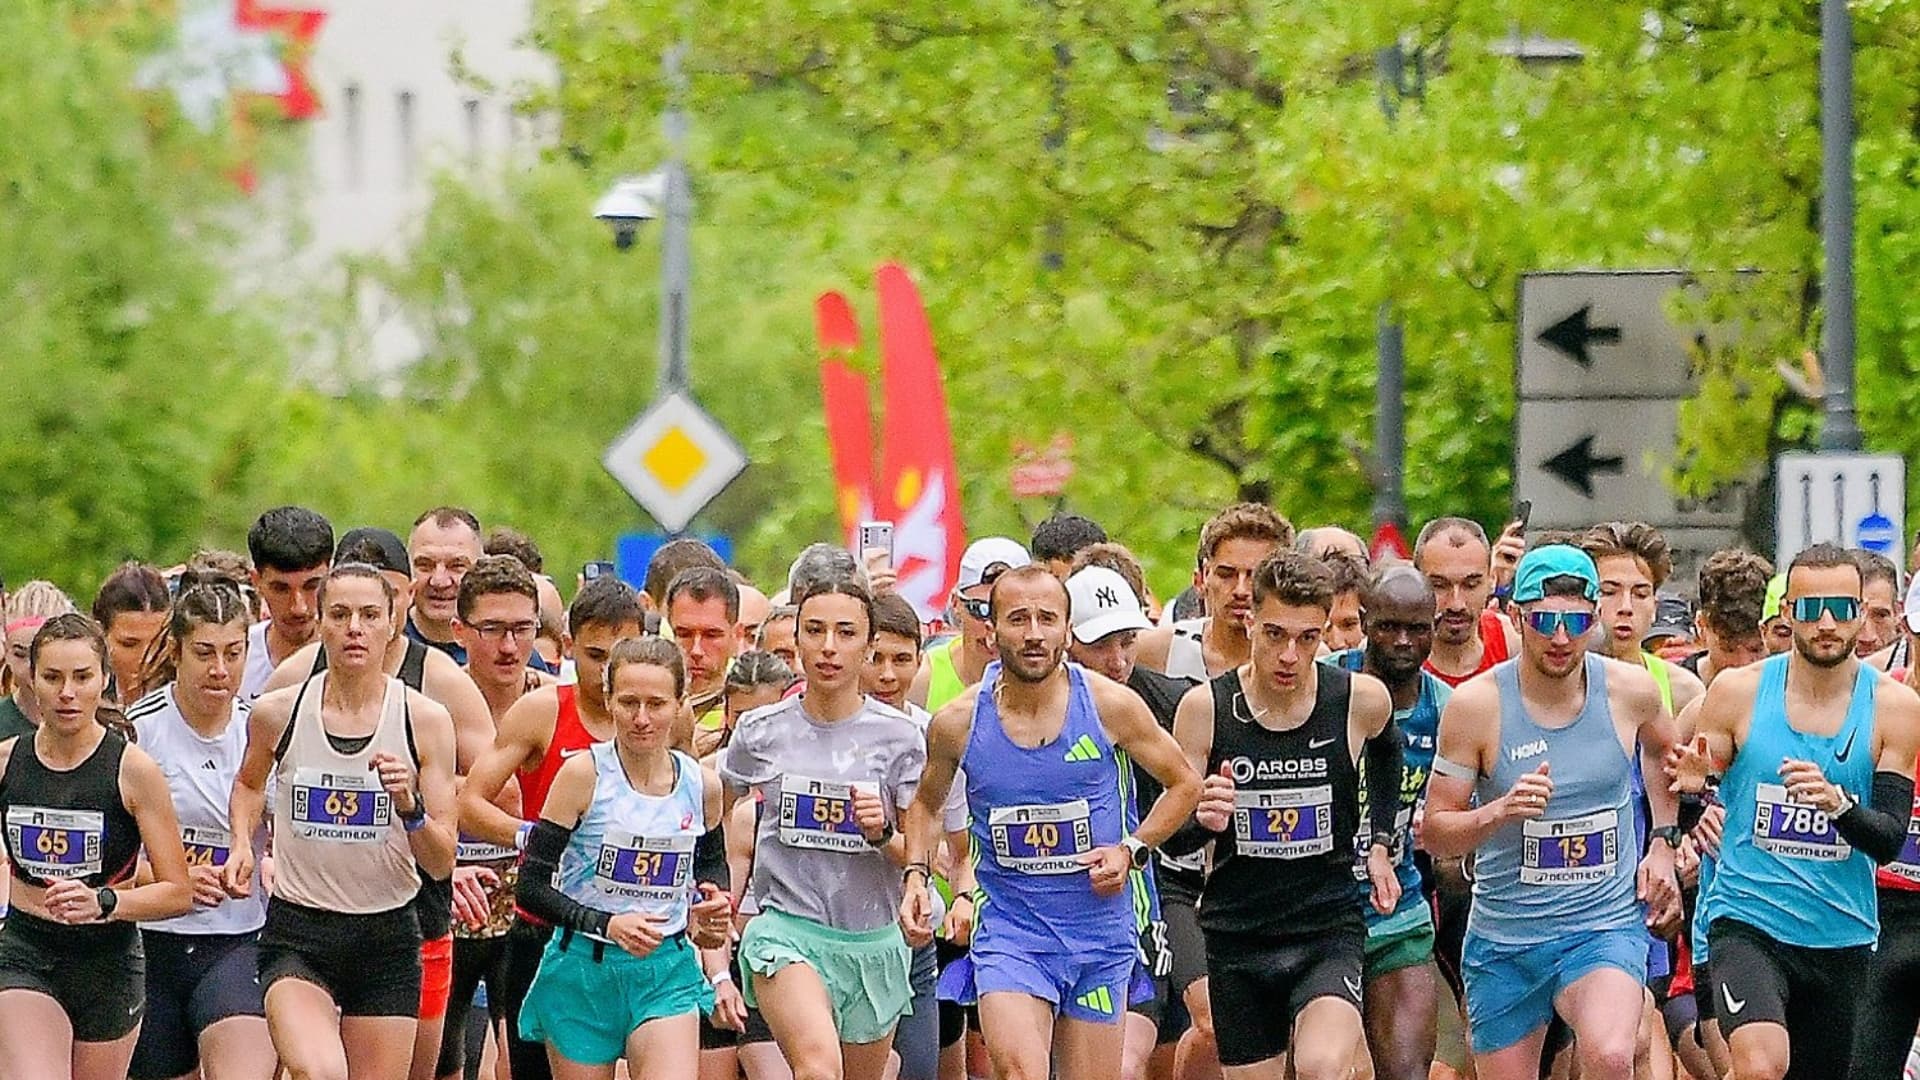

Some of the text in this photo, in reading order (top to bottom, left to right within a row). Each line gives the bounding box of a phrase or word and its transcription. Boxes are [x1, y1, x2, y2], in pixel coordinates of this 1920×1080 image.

[1511, 740, 1548, 761] HOKA
[1256, 758, 1328, 774] AROBS
[325, 790, 359, 817] 63
[813, 797, 846, 825] 55
[1267, 808, 1299, 834] 29
[1780, 806, 1829, 836] 788
[36, 828, 70, 855] 65
[318, 828, 377, 841] DECATHLON
[805, 834, 864, 849] DECATHLON
[1023, 823, 1059, 848] 40
[1263, 842, 1321, 855] DECATHLON
[1558, 835, 1587, 860] 13
[1778, 844, 1838, 859] DECATHLON
[632, 851, 663, 878] 51
[1023, 859, 1076, 872] DECATHLO
[1549, 869, 1608, 882] DECATHLON
[619, 887, 674, 900] DECATHLON
